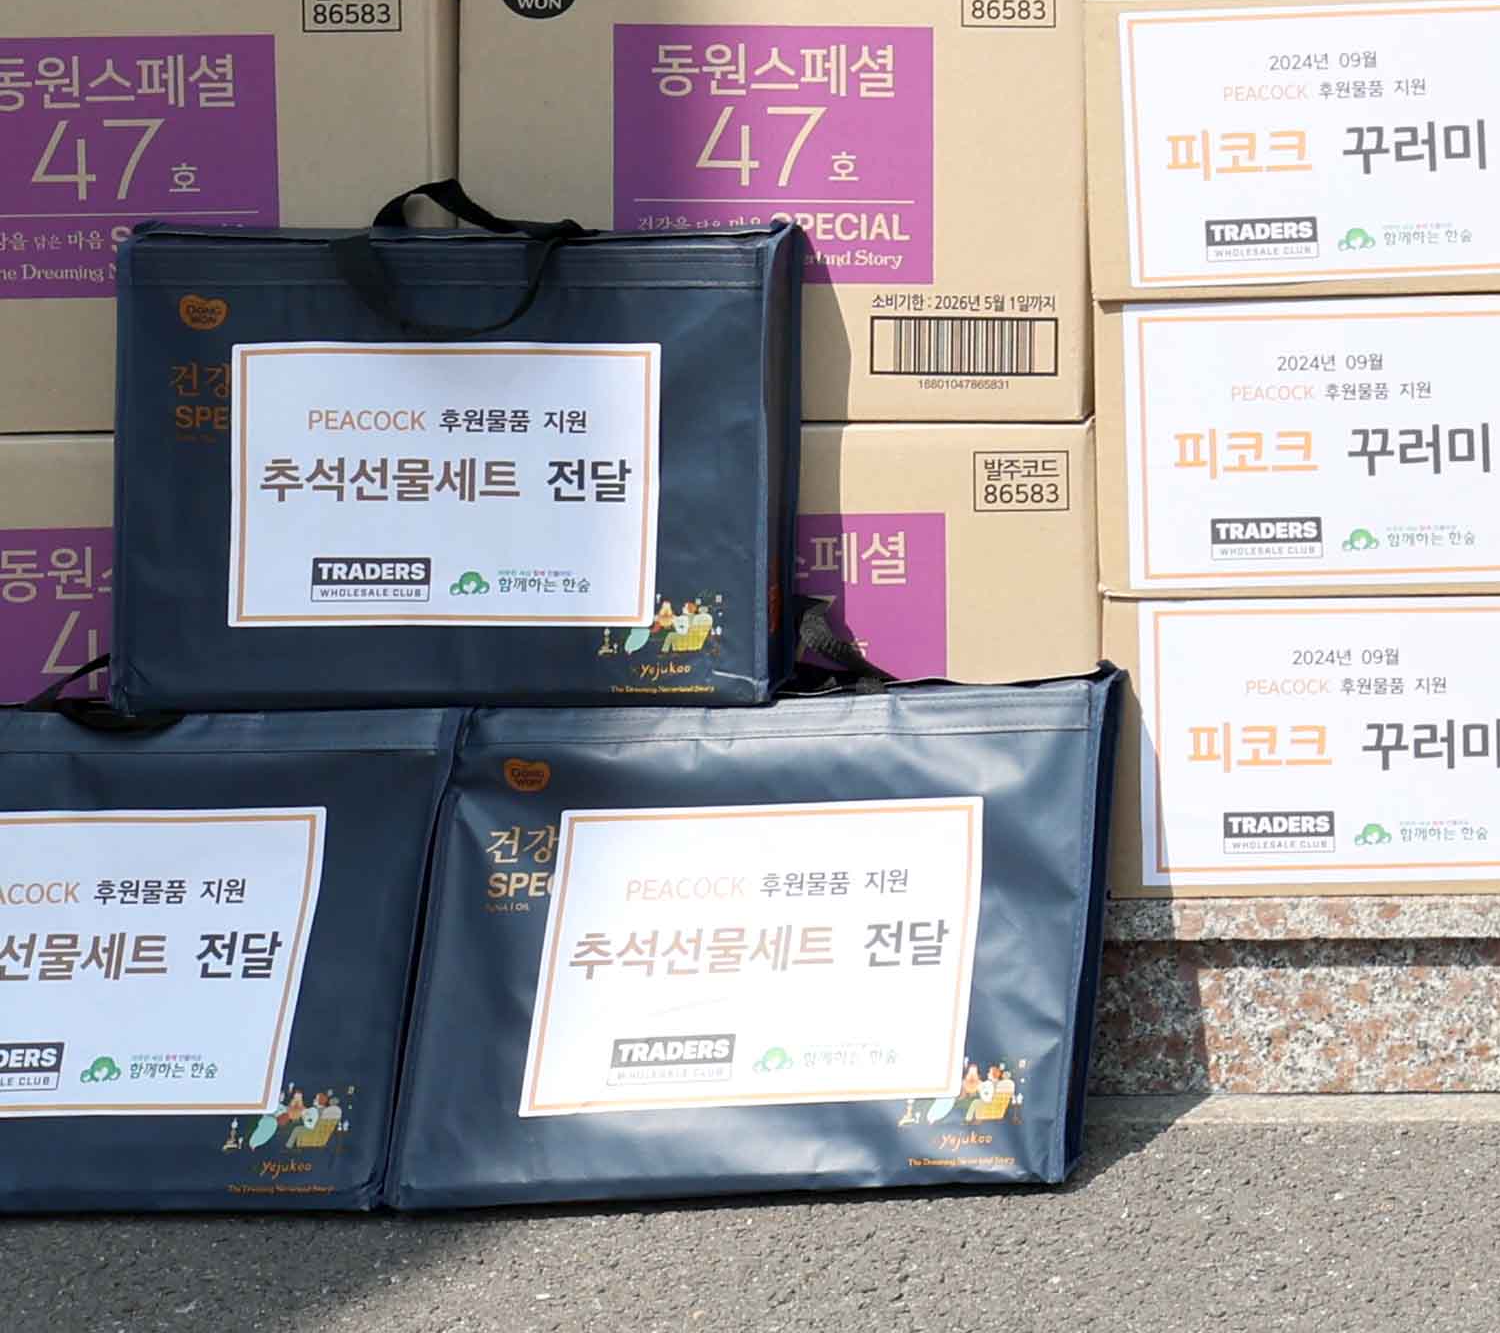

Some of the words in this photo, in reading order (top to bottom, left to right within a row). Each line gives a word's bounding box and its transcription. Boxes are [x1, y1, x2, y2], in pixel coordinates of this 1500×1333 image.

[308, 409, 426, 431] PEACOCK
[439, 408, 531, 434] 후원물품
[543, 408, 587, 434] 지원
[260, 457, 520, 503] 추석선물세트
[547, 458, 633, 503] 전달
[318, 562, 425, 581] TRADERS
[320, 588, 388, 598] WHOLESALE
[392, 588, 421, 598] CLUB
[498, 576, 557, 595] 함께하는
[561, 576, 591, 594] 한숲
